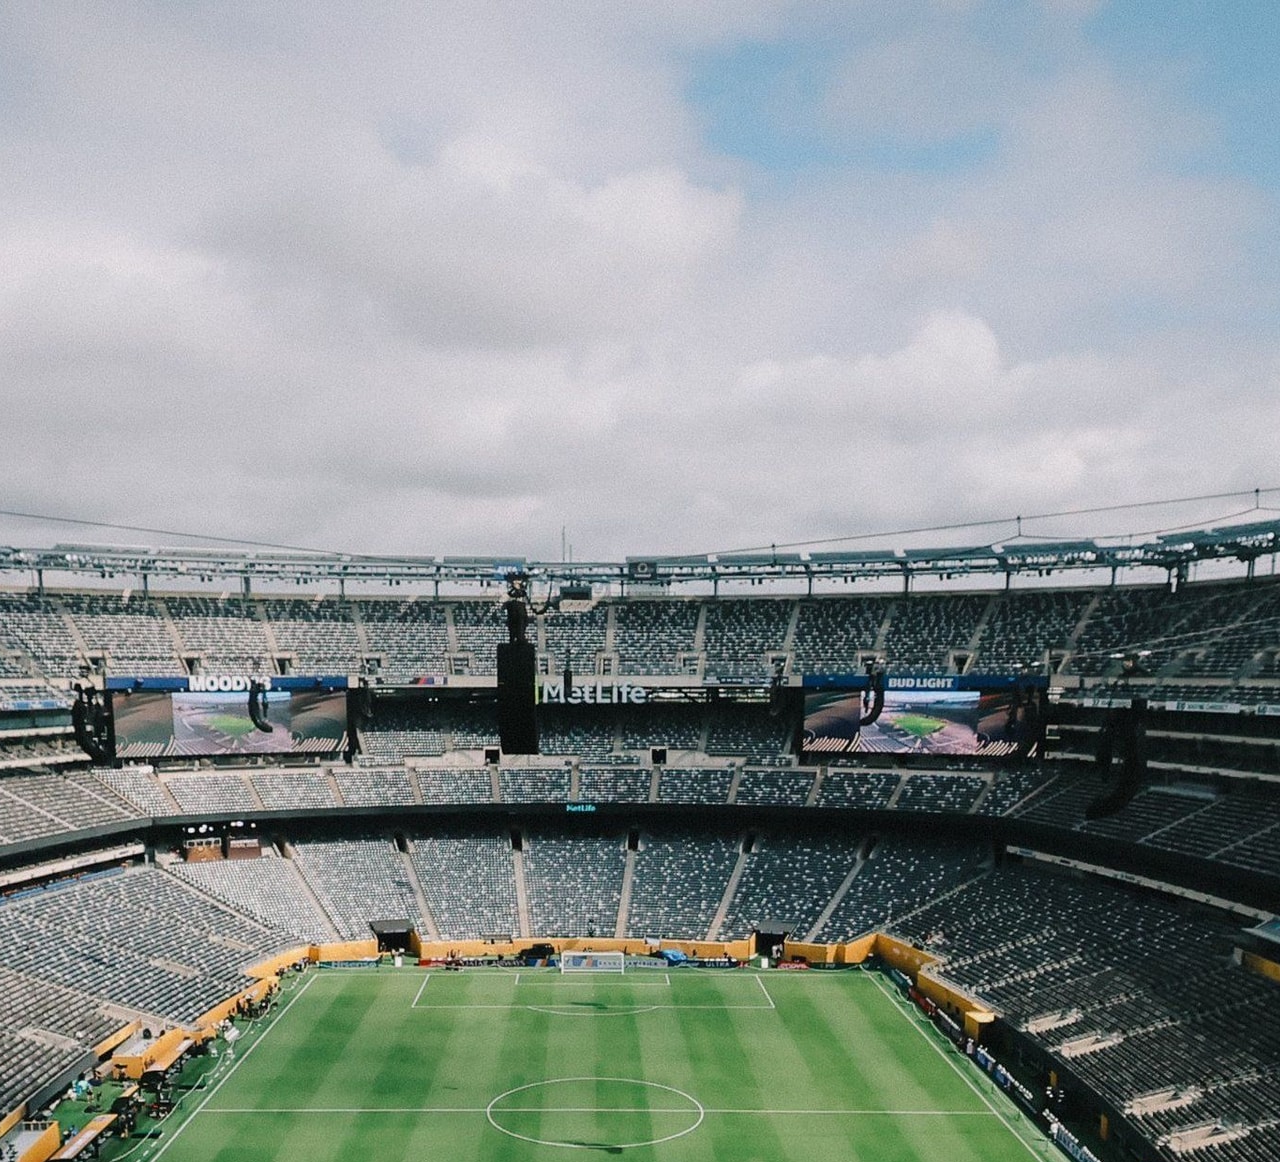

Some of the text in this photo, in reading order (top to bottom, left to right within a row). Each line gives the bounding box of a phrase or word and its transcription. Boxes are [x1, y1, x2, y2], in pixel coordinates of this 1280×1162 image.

[888, 677, 955, 689] BUD LIGHT
[542, 681, 648, 705] MetLife
[566, 804, 596, 812] MetLife
